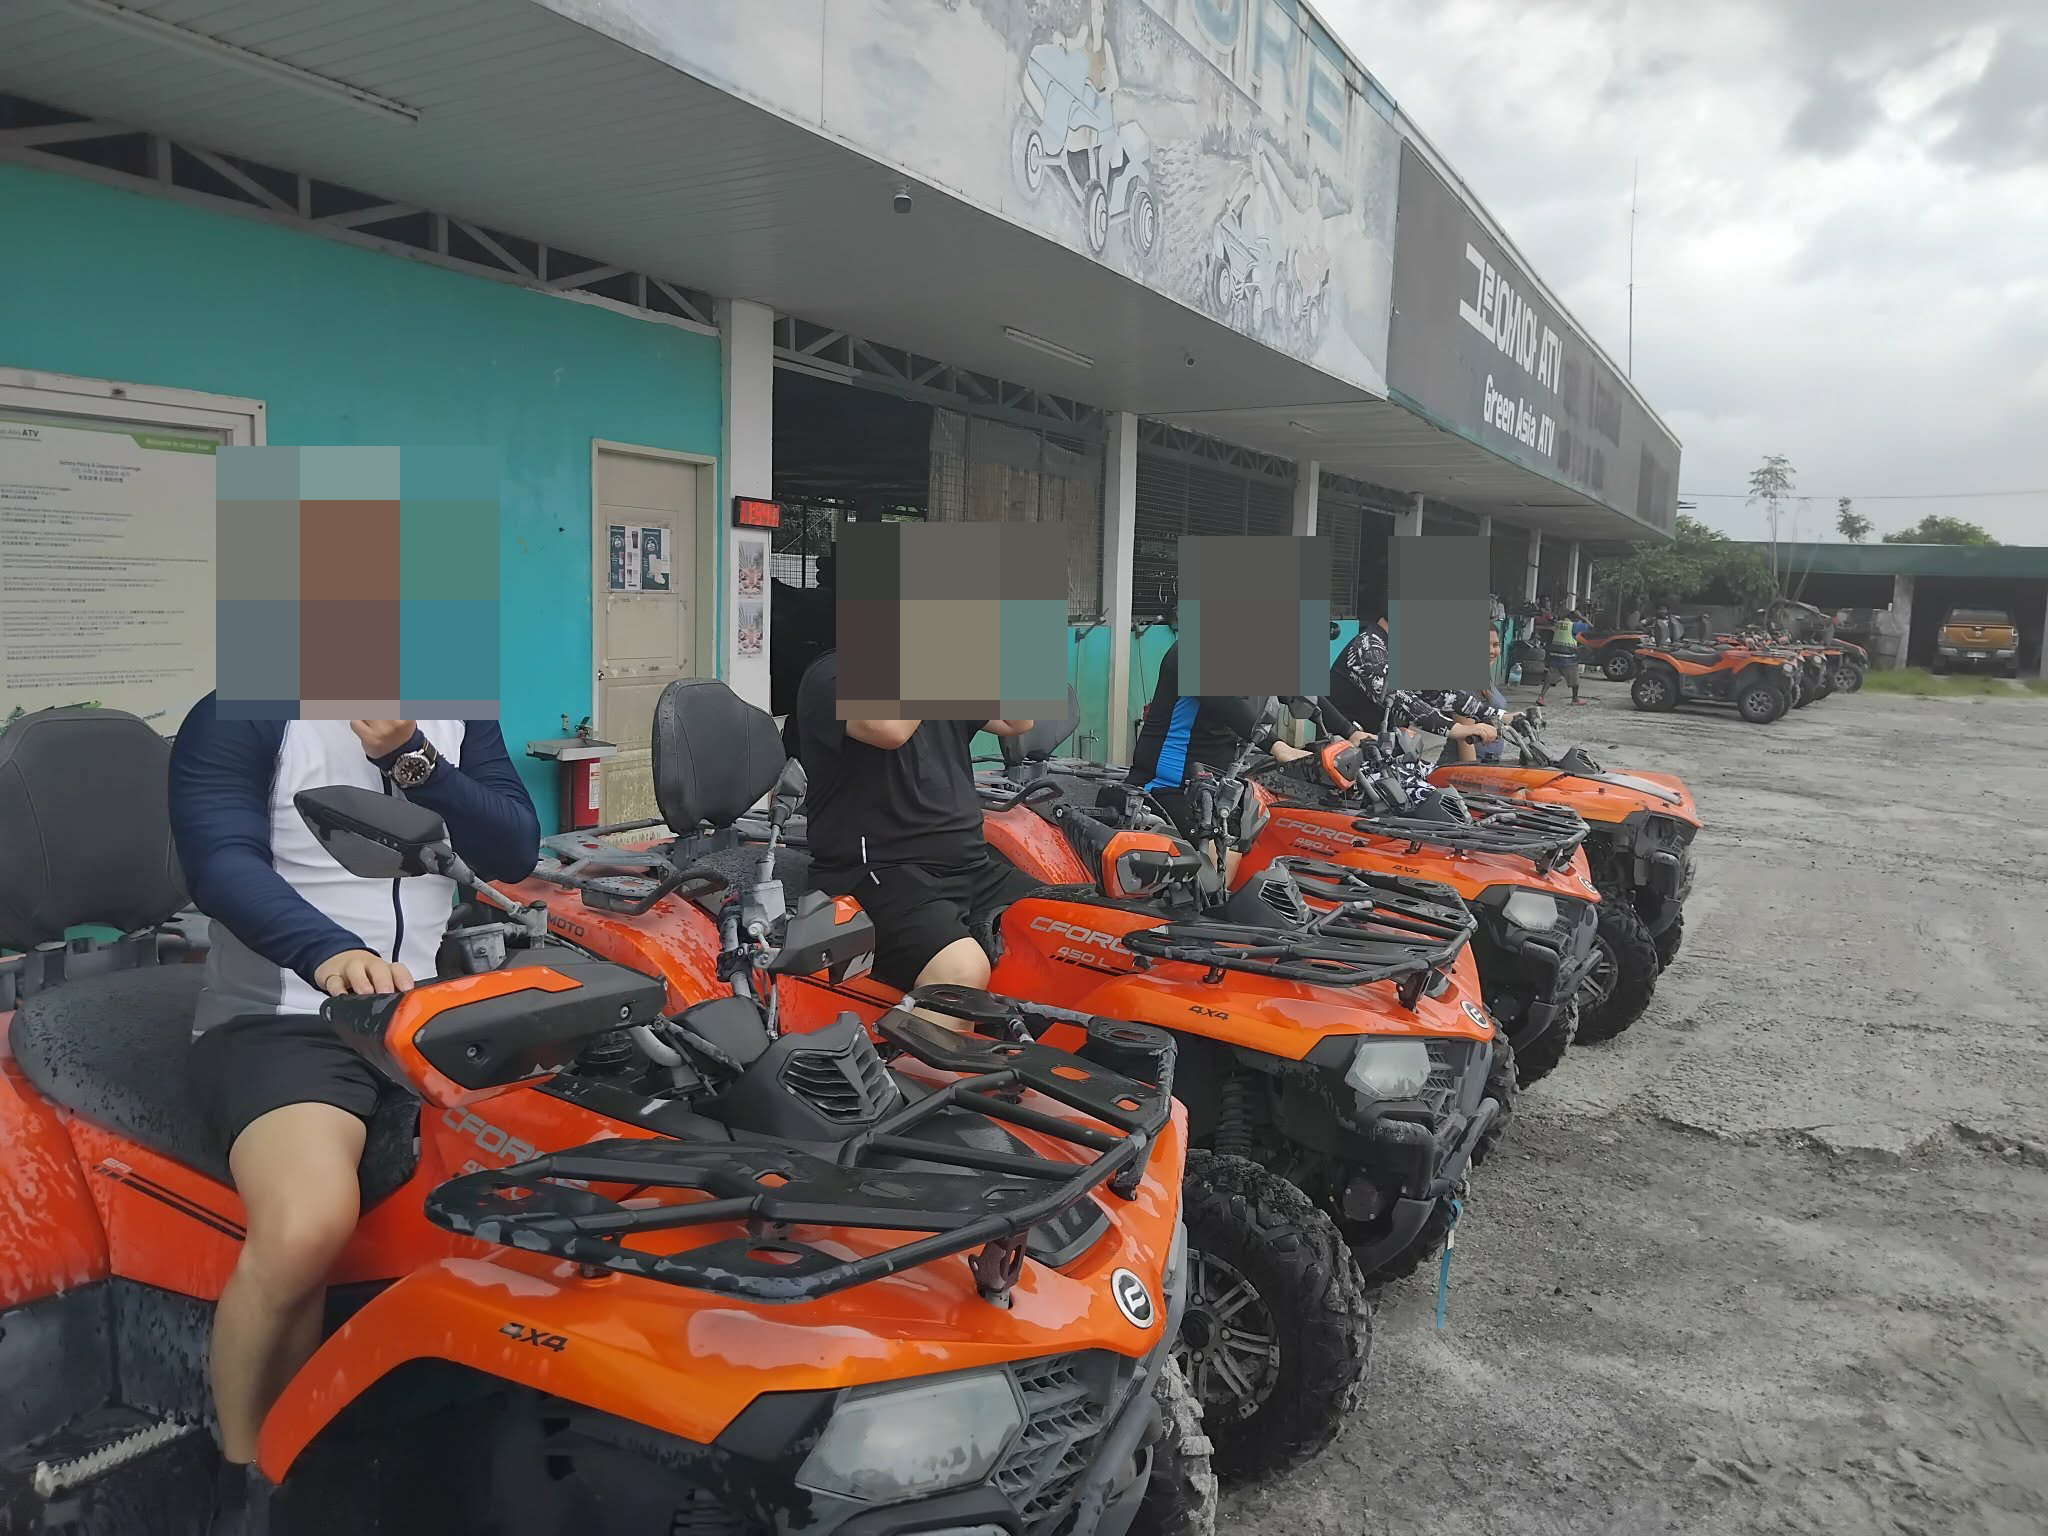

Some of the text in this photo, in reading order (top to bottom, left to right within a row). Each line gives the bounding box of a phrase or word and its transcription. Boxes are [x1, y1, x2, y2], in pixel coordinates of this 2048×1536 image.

[1459, 242, 1563, 394] 그린아시아 ATV
[1483, 374, 1556, 457] Green Asia ATV
[22, 429, 39, 438] ATV
[1274, 817, 1372, 847] CFORCE
[1030, 916, 1142, 958] CFORC
[1056, 946, 1096, 964] 450
[1187, 1005, 1229, 1021] 4X4
[442, 1105, 550, 1170] CFOR
[499, 1322, 569, 1353] 4X4
